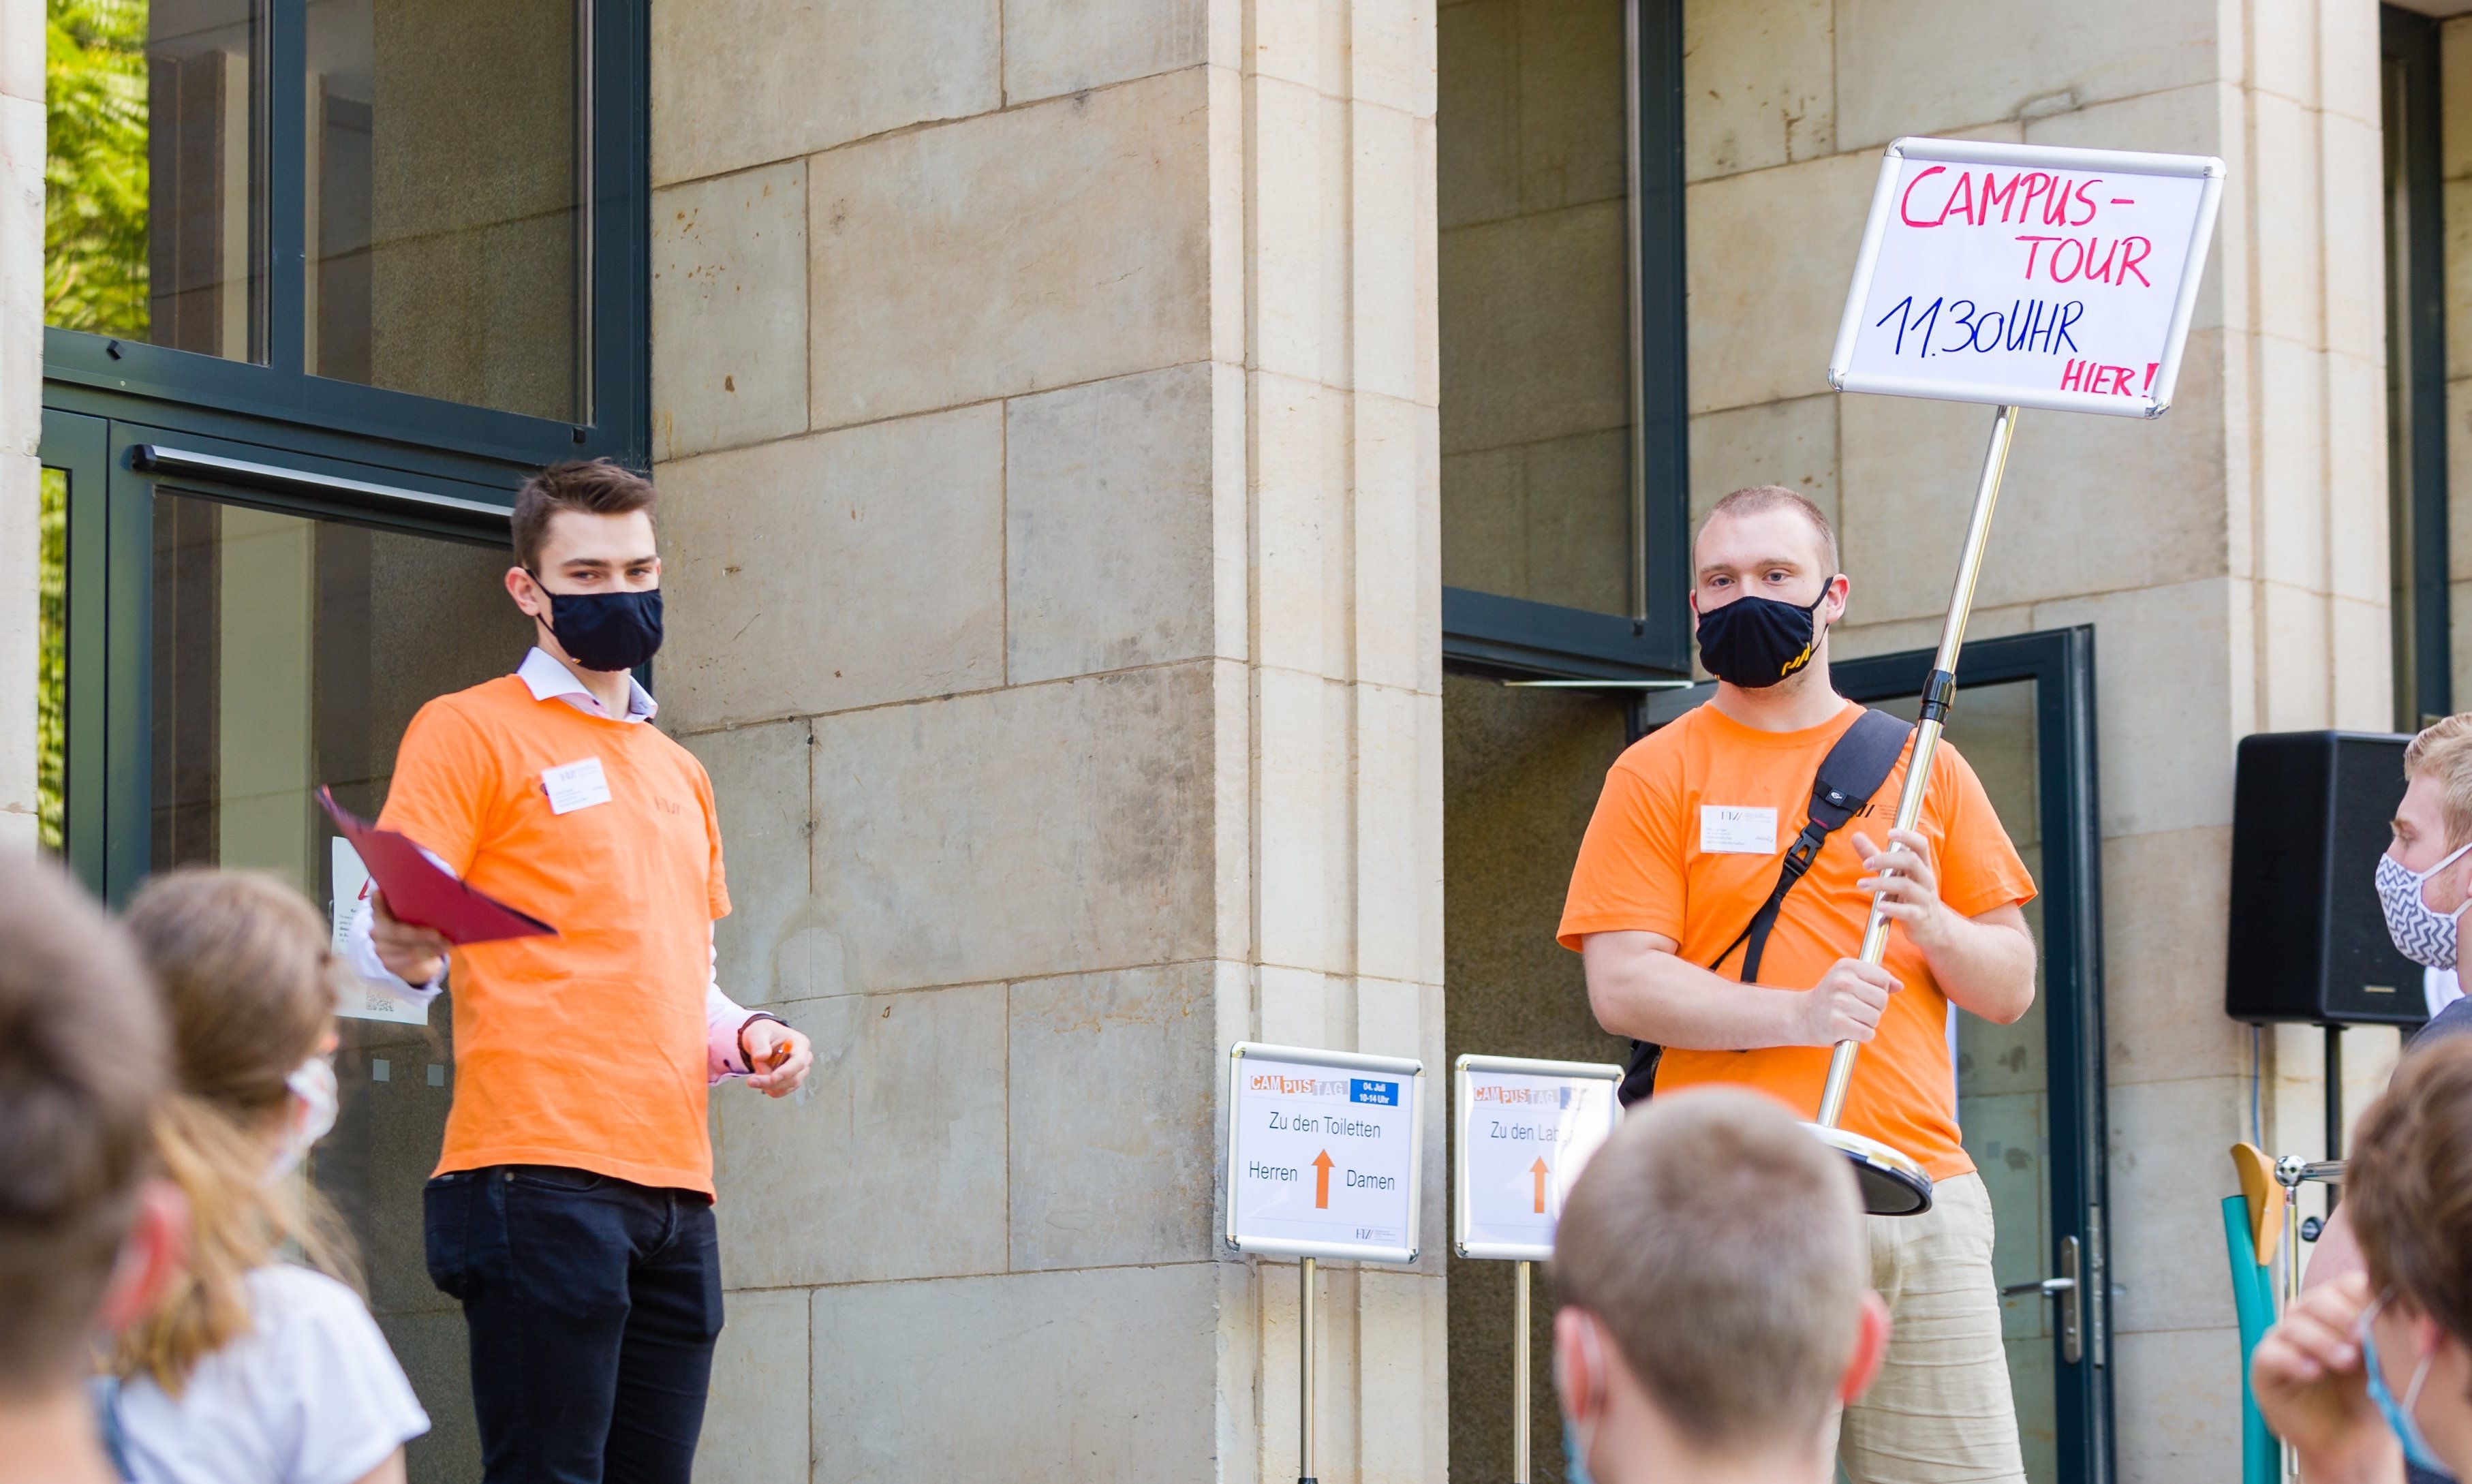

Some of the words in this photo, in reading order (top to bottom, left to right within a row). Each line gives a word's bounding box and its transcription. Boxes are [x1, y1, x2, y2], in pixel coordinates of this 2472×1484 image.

[1901, 166, 2134, 228] CAMPUS-
[2015, 236, 2151, 288] TOUR
[1269, 1112, 1287, 1130] Zu
[1293, 1115, 1318, 1132] den
[1324, 1117, 1380, 1138] Toiletten
[1491, 1122, 1507, 1139] Zu
[1511, 1123, 1534, 1140] den
[1250, 1161, 1297, 1181] Herren
[1347, 1170, 1394, 1190] Damen
